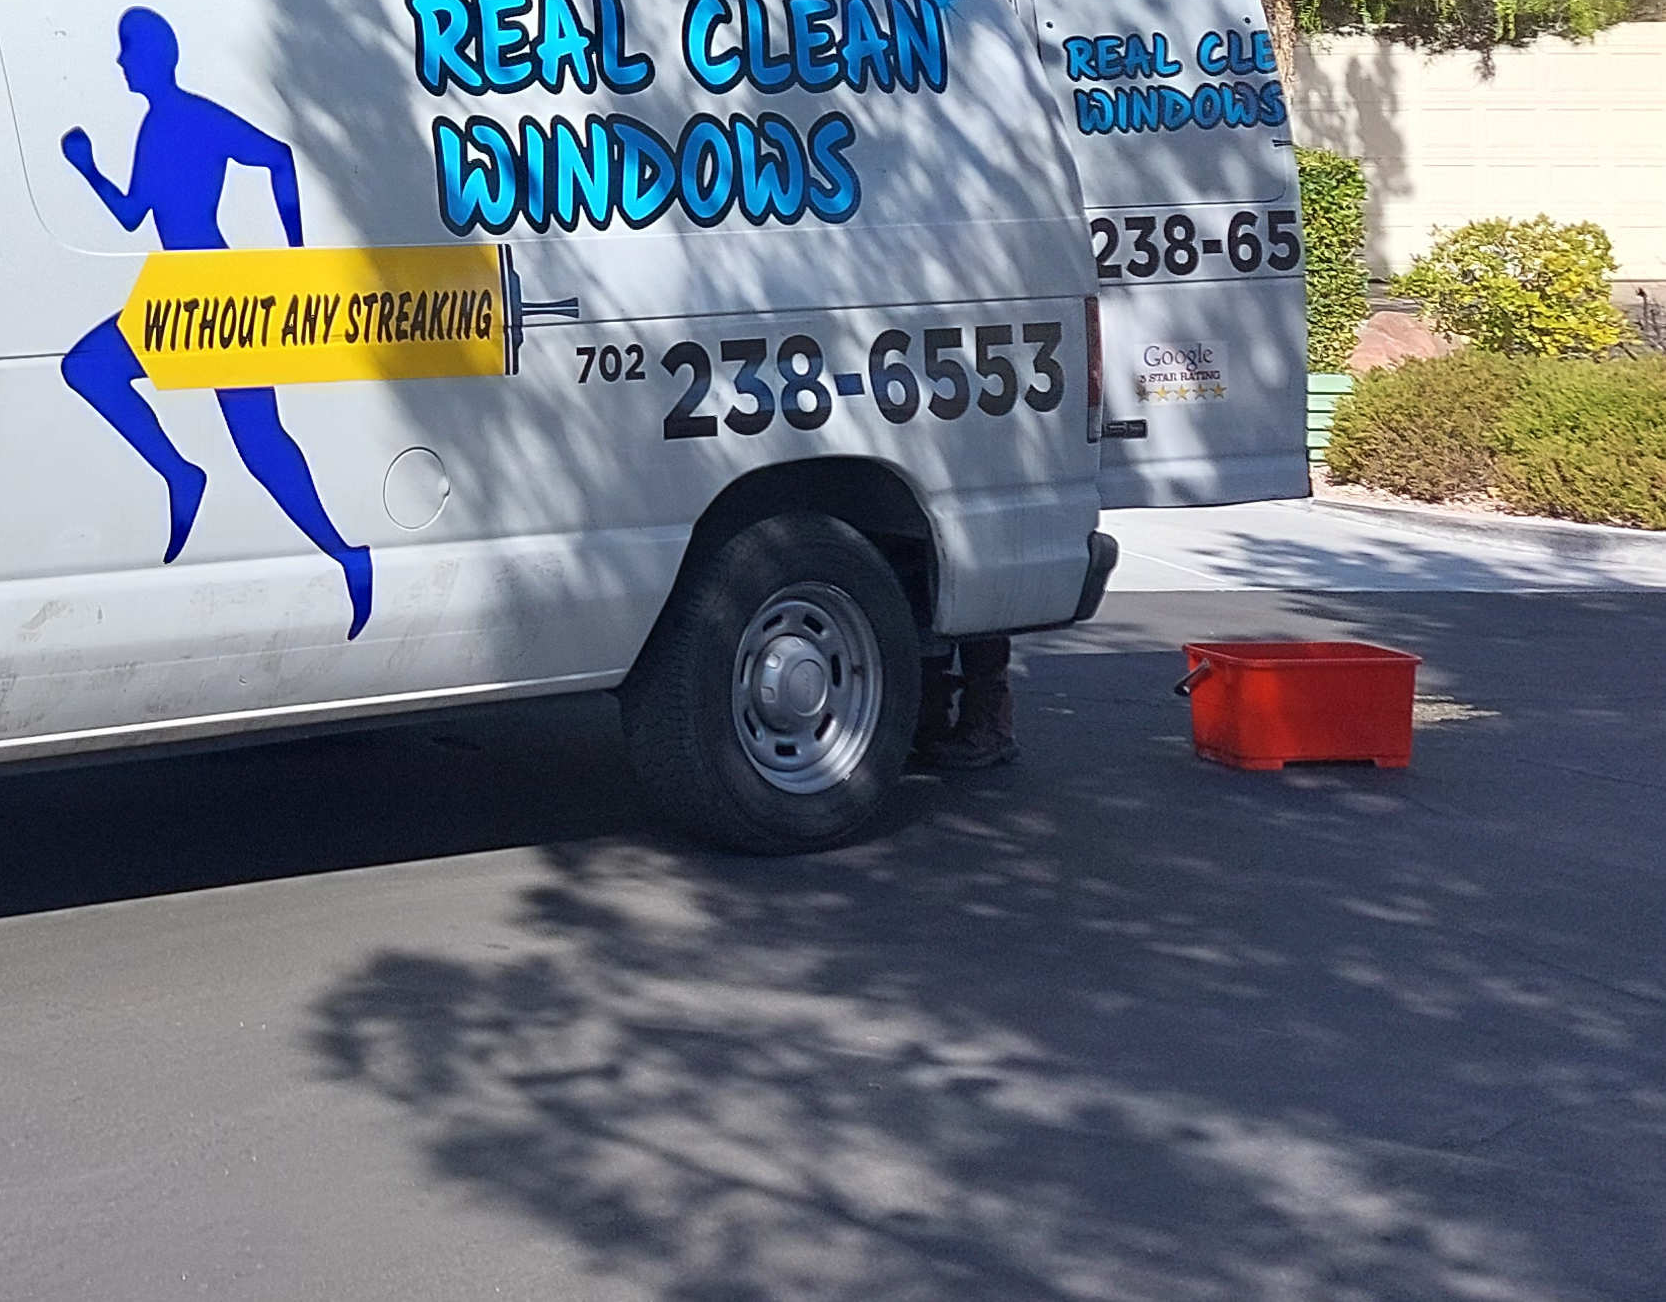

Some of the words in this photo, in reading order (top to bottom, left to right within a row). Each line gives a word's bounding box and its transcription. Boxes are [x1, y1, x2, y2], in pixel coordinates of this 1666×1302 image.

[1063, 32, 1182, 82] REAL
[1073, 80, 1287, 136] WINDOWS
[433, 112, 860, 236] WINDOWS
[1090, 210, 1301, 279] 238-65
[144, 296, 277, 352] WITHOUT
[281, 292, 340, 346] ANY
[345, 290, 493, 343] STREAKING
[575, 343, 646, 383] 702
[660, 321, 1065, 440] 238-6553
[1143, 343, 1214, 372] Google
[1148, 372, 1178, 383] STAR
[1180, 370, 1221, 381] RATING
